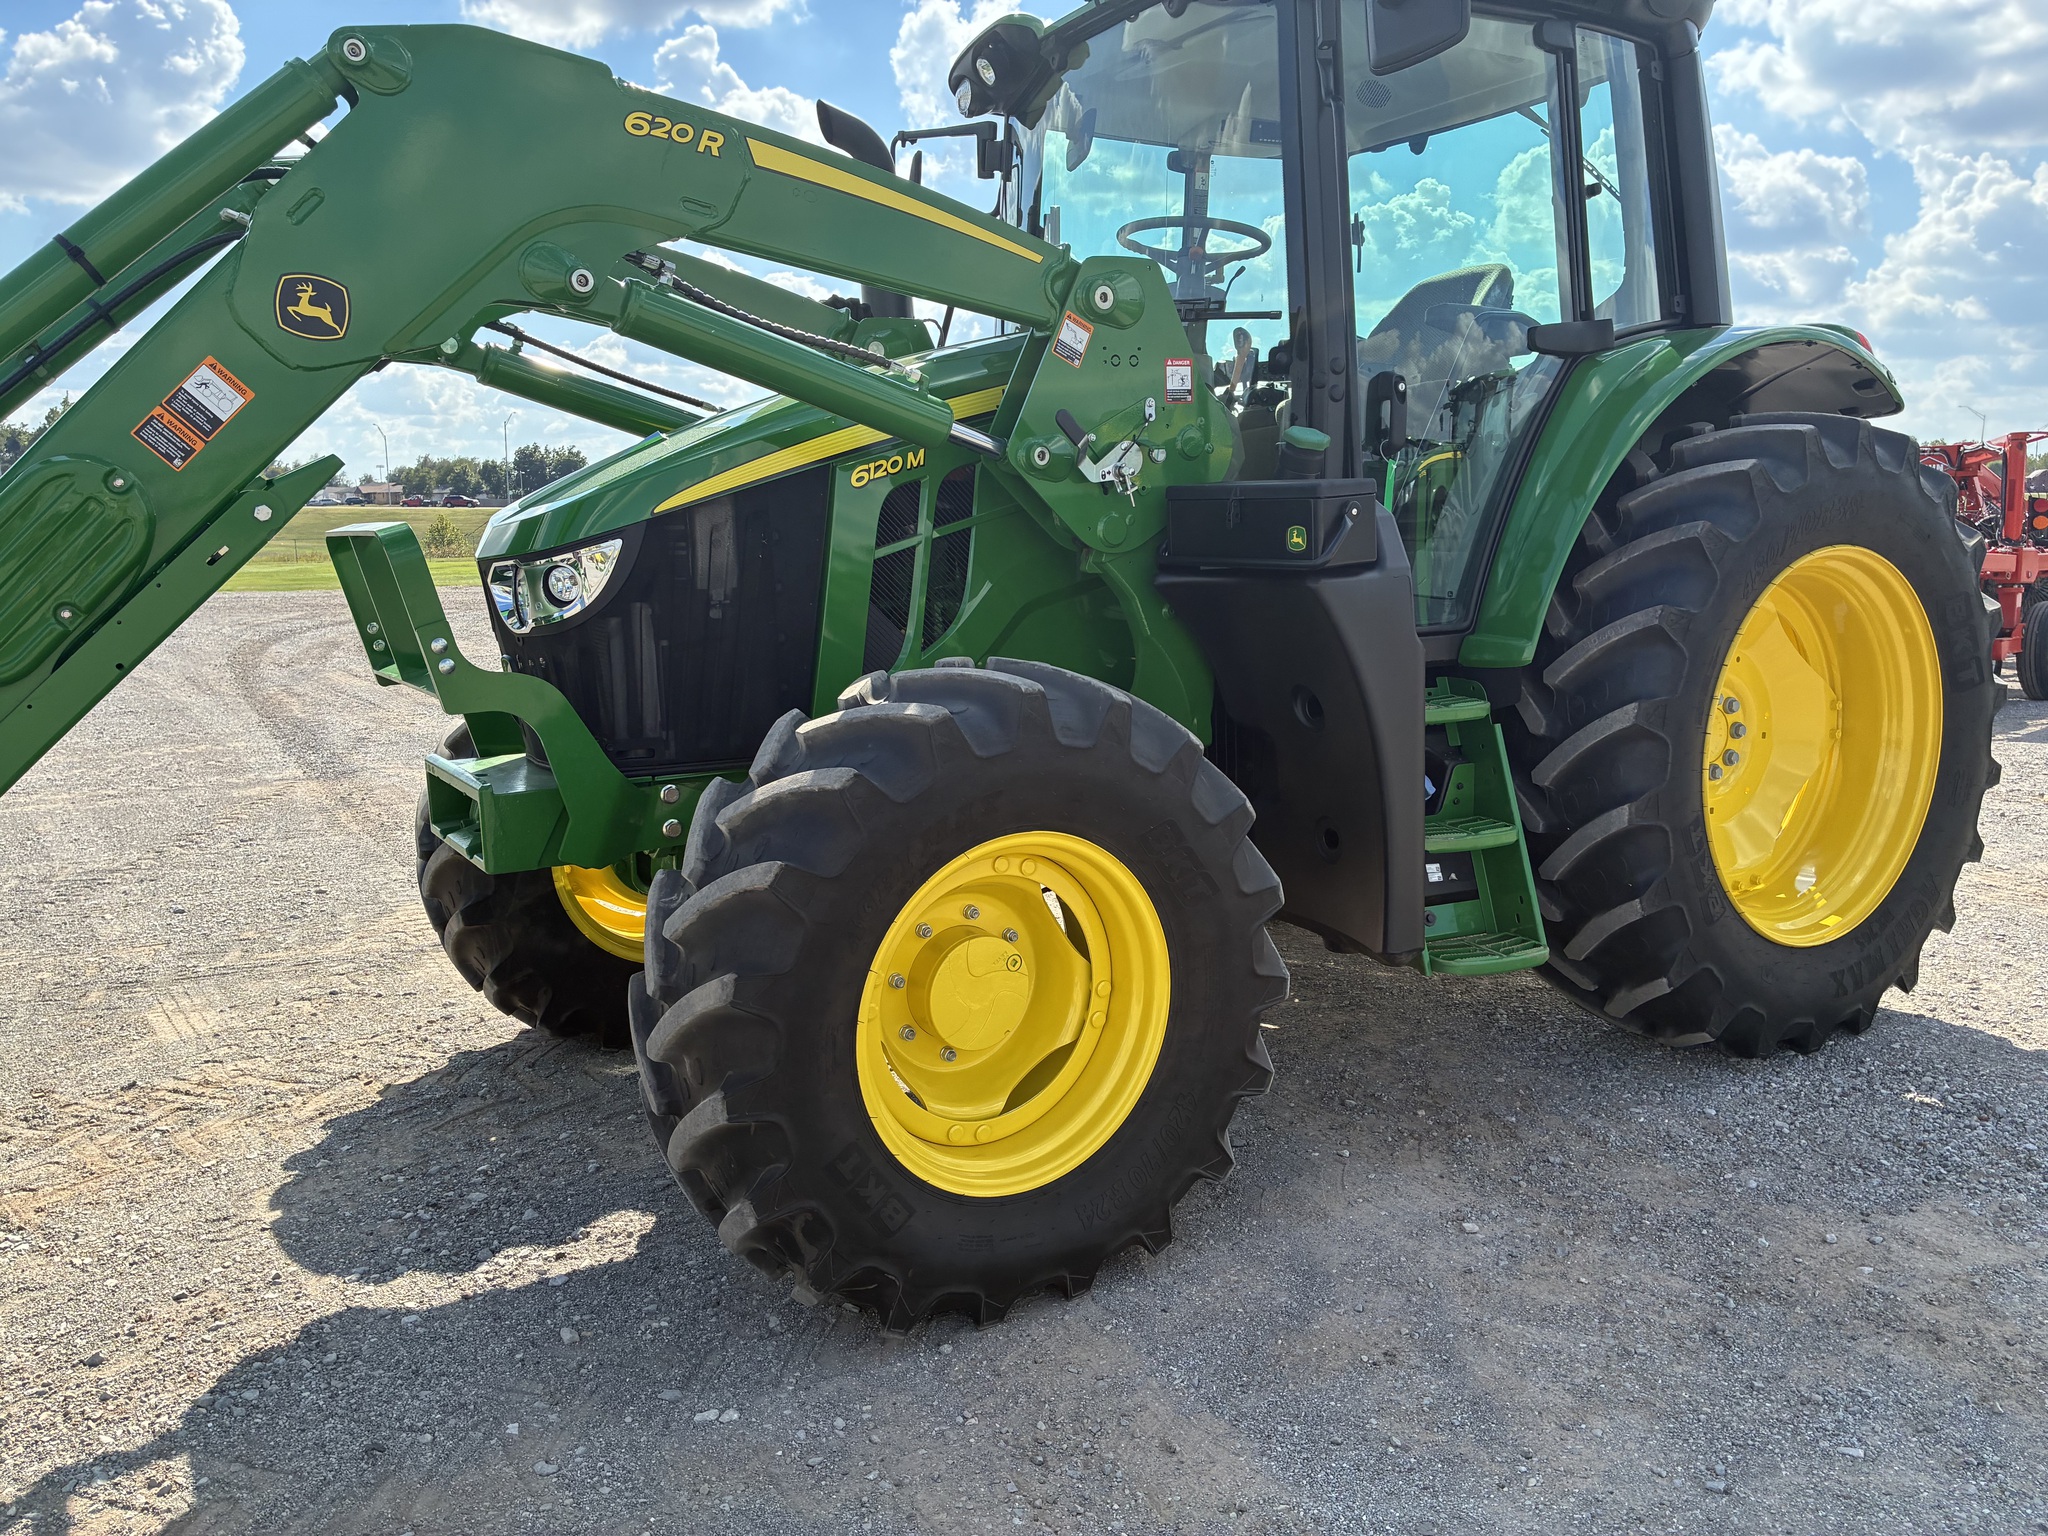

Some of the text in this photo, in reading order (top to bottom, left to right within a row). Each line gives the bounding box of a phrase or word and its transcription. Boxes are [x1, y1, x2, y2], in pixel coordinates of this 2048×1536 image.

[623, 110, 726, 158] 620 R
[1072, 317, 1092, 333] WARNING
[216, 367, 248, 396] WARNING
[166, 418, 198, 447] WARNING
[850, 447, 926, 488] 6120 M
[832, 1149, 912, 1233] BKT
